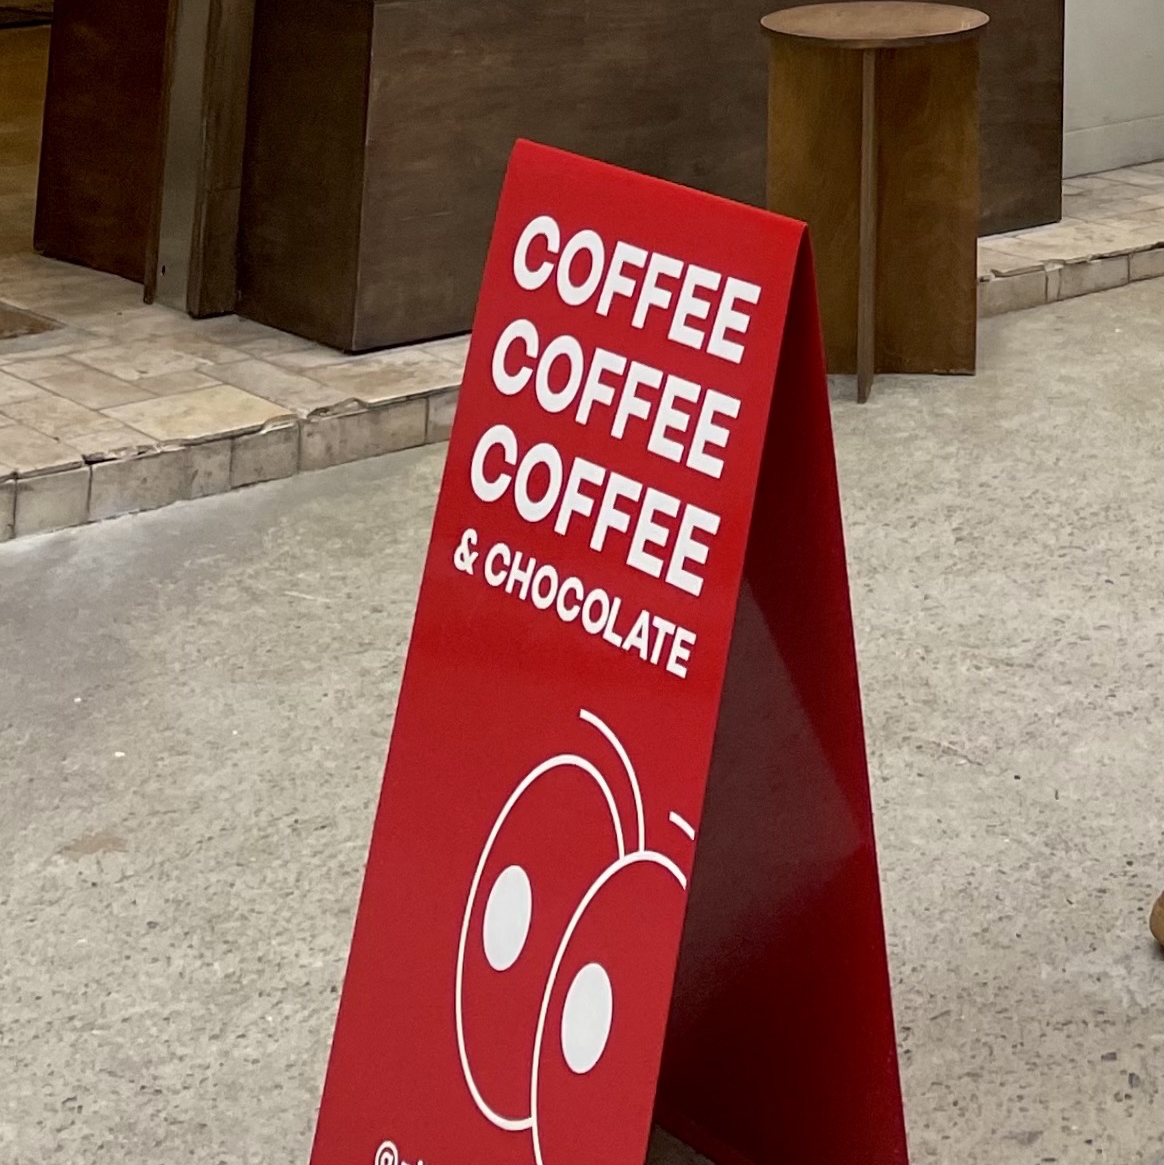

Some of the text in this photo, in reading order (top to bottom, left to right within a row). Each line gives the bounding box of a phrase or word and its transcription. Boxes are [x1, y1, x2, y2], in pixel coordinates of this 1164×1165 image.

[512, 214, 762, 365] COFFEE
[491, 318, 742, 479] COFFEE
[470, 424, 722, 598] COFFEE
[453, 528, 697, 679] & CHOCOLATE
